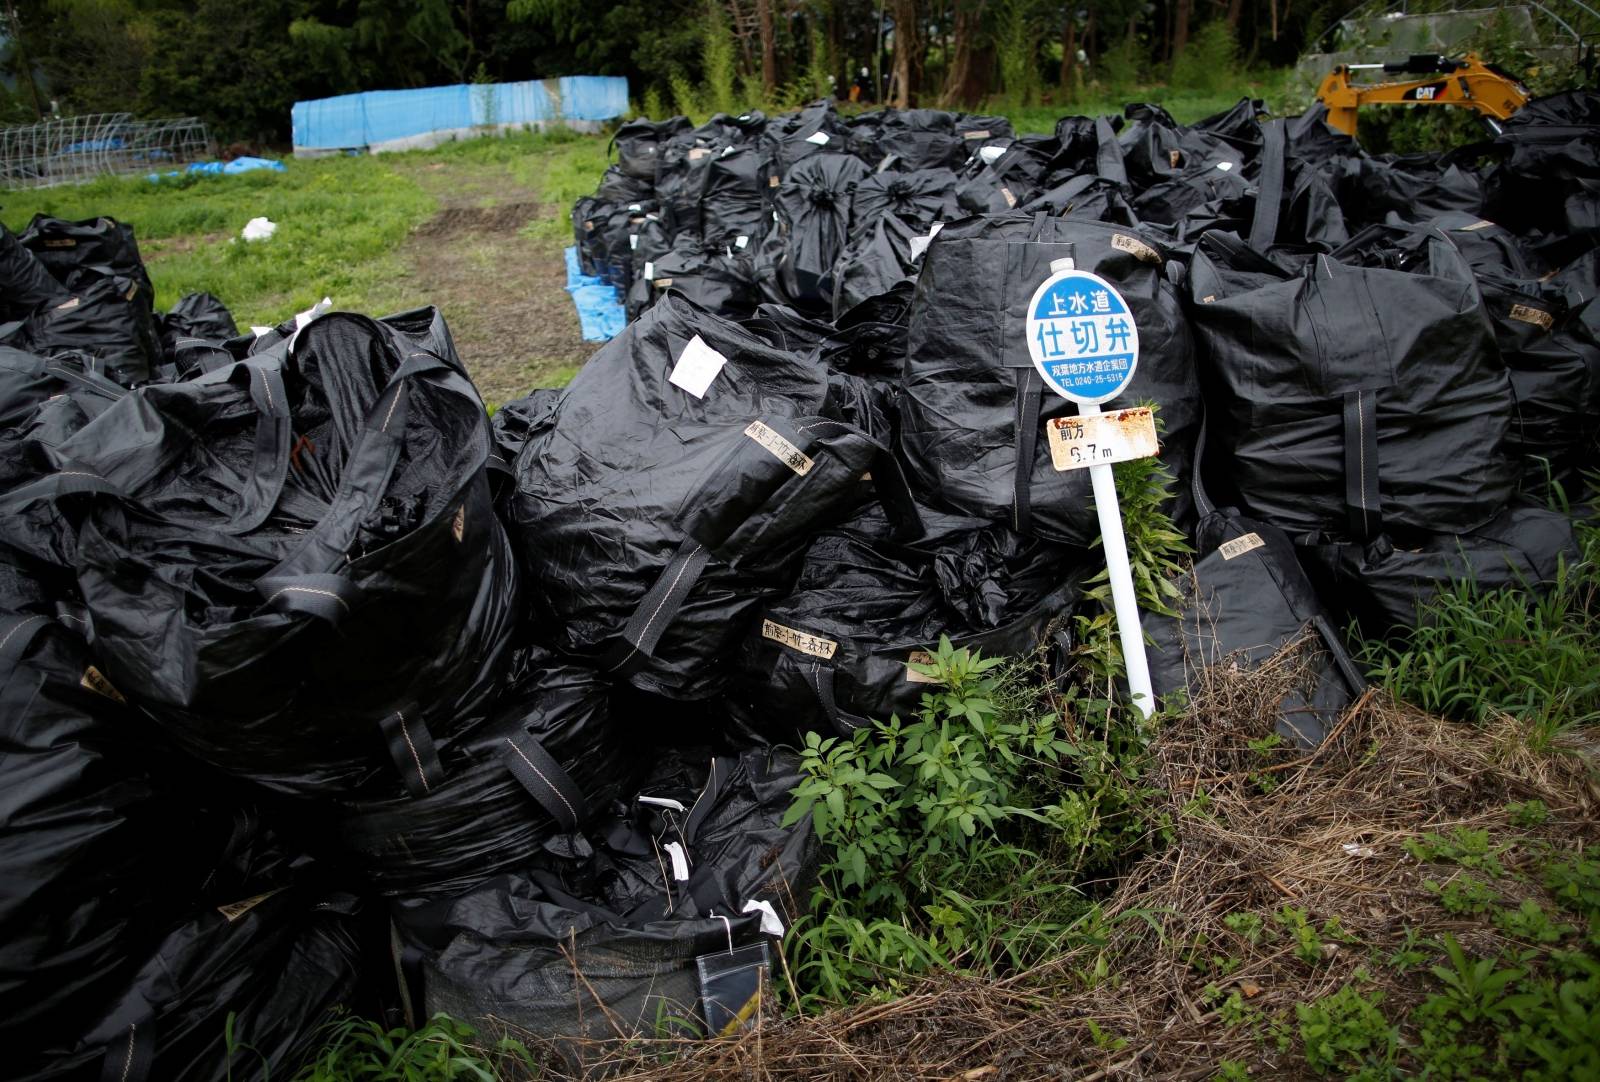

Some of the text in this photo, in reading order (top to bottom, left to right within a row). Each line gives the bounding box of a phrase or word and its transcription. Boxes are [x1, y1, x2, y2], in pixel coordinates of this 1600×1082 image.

[1416, 87, 1436, 99] CAT
[1048, 290, 1111, 315] 上水道
[1037, 317, 1131, 358] 仕切弁
[1052, 359, 1127, 376] 双葉地方水道企業団
[1061, 378, 1074, 388] TEL
[1059, 422, 1084, 440] 前方
